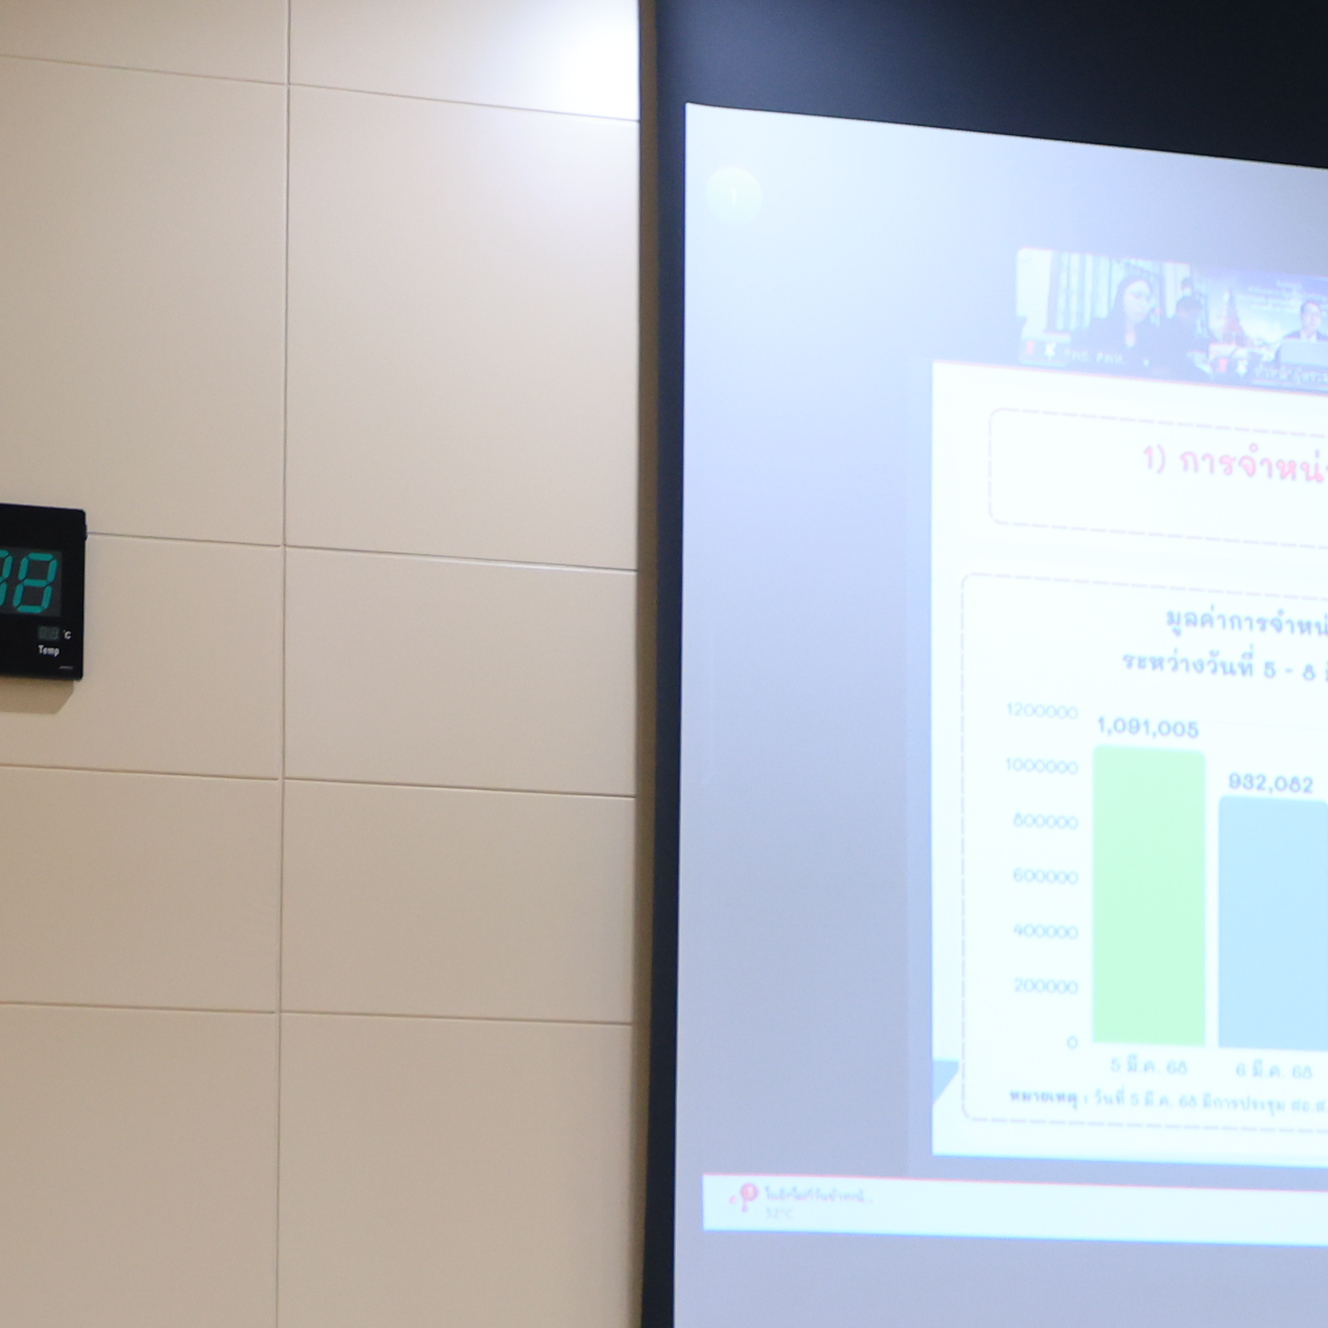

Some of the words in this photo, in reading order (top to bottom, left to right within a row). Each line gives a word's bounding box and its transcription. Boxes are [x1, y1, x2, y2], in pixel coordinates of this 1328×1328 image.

[1143, 444, 1167, 474] 1)
[38, 644, 60, 658] Temp
[1122, 643, 1255, 677] ระหว่างวันที่
[1263, 660, 1277, 679] 5
[1301, 663, 1317, 681] 8
[1006, 701, 1079, 720] 1200000
[1097, 715, 1200, 739] 1,091,005
[1005, 756, 1079, 775] 1000000
[1012, 811, 1079, 830] 800000
[1012, 867, 1079, 885] 600000
[1013, 922, 1079, 940] 400000
[1014, 977, 1079, 994] 200000
[1065, 1034, 1080, 1051] 0
